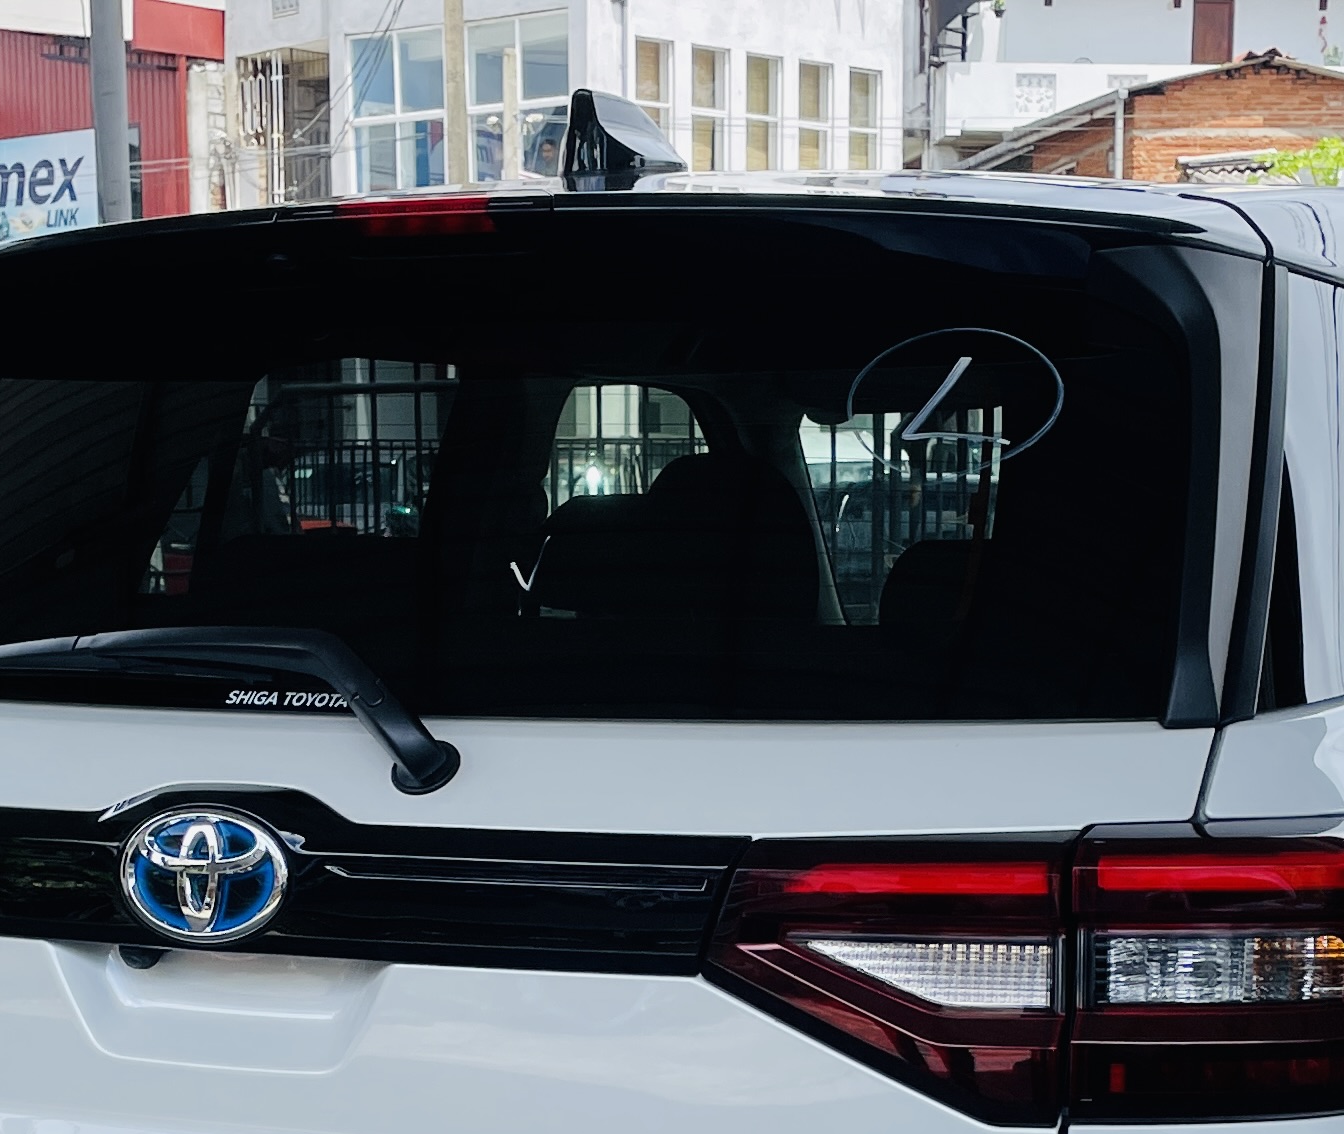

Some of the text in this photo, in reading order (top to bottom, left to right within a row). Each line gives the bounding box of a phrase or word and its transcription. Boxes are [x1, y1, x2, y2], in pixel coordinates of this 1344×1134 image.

[46, 208, 79, 228] LINK
[225, 689, 348, 708] SHIGA TOYOTA
